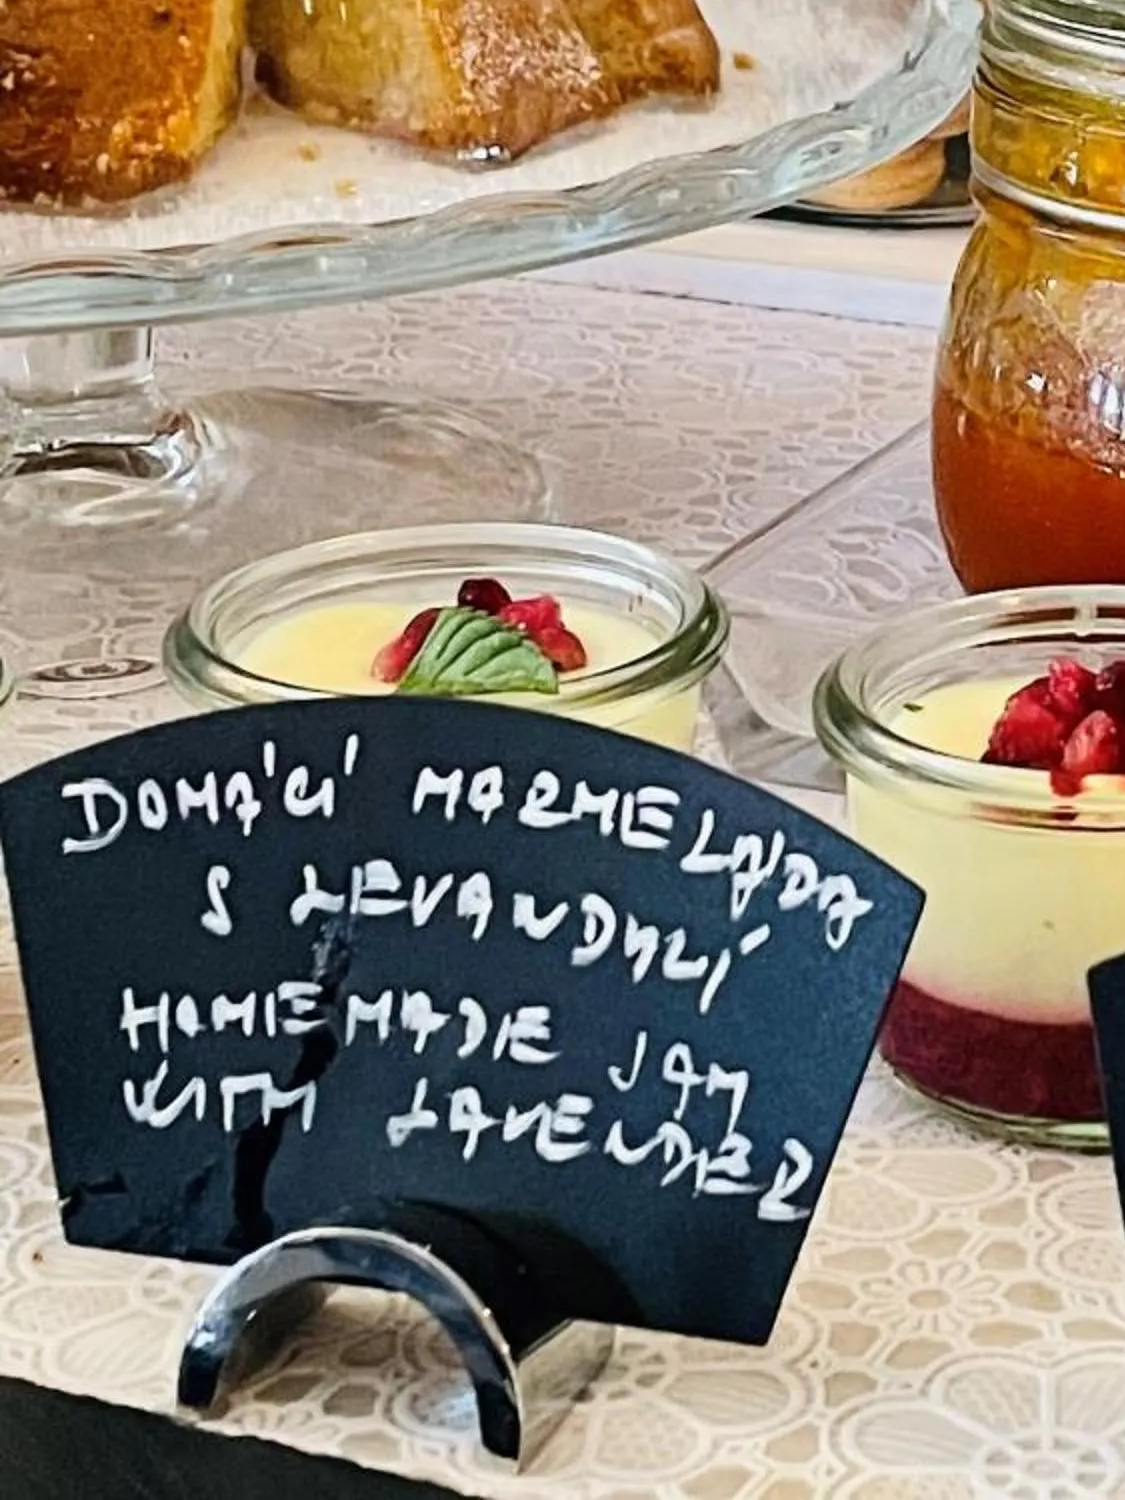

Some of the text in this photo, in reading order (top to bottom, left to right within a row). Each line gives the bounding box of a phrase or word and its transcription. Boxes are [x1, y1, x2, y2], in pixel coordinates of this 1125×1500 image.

[201, 865, 232, 937] S
[608, 1031, 750, 1134] JAM
[123, 1058, 816, 1222] WITH LAVENDER
